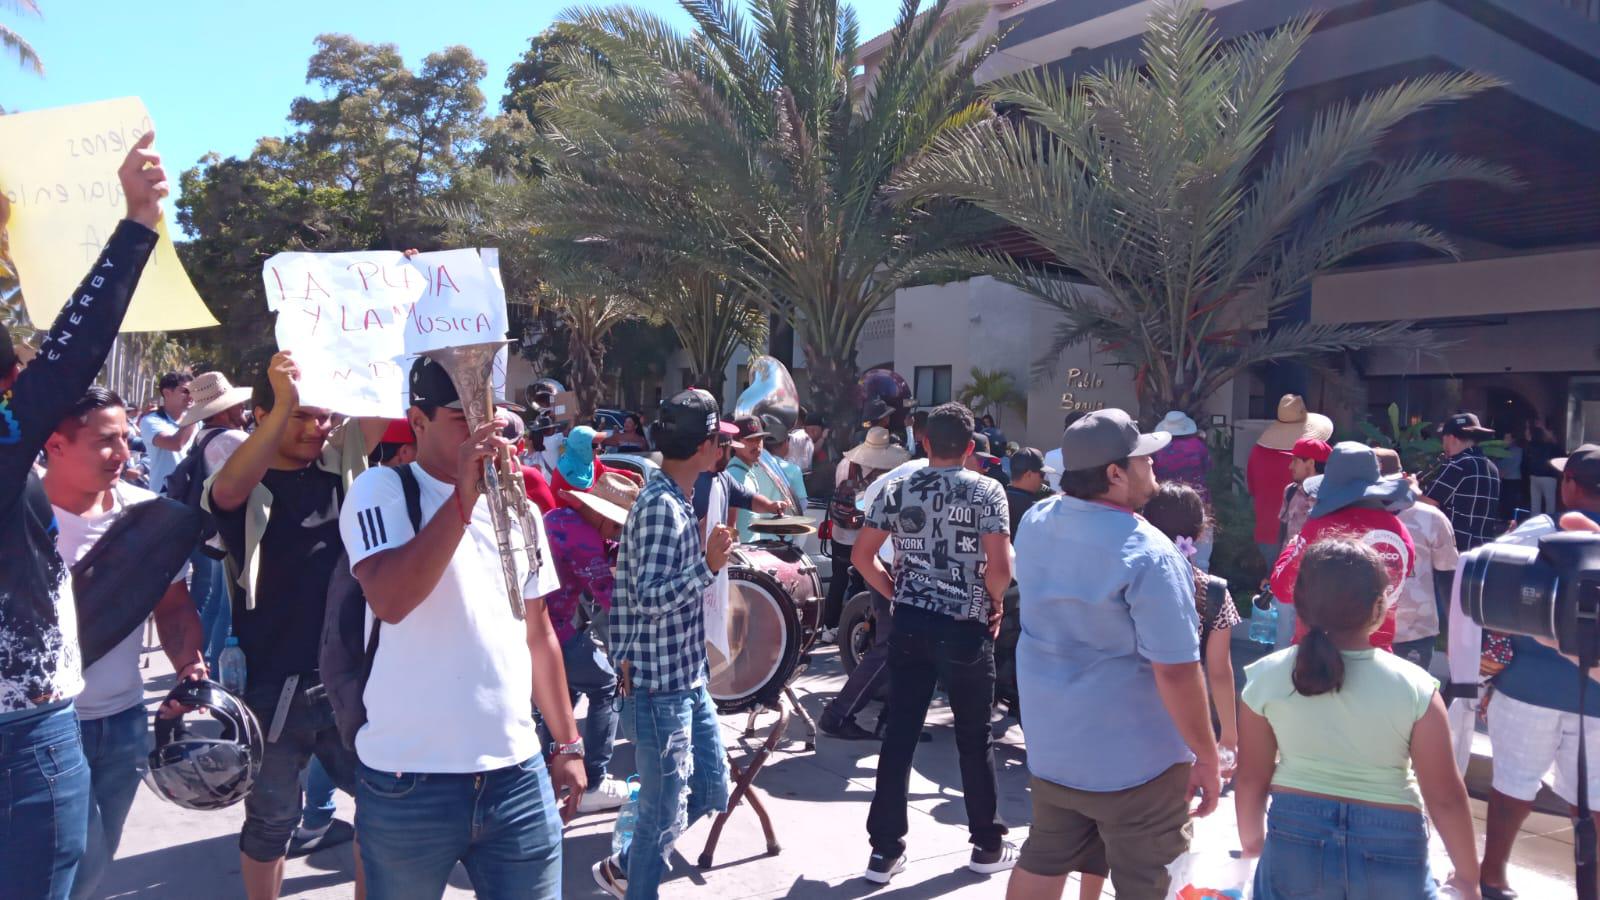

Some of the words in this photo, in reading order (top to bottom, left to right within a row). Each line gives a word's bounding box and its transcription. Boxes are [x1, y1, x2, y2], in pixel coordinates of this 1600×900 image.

[271, 266, 331, 301] LA
[48, 258, 114, 361] ENERGY
[302, 305, 321, 336] Y
[341, 305, 384, 331] LA
[948, 505, 971, 524] ZOO
[900, 538, 924, 550] YORK
